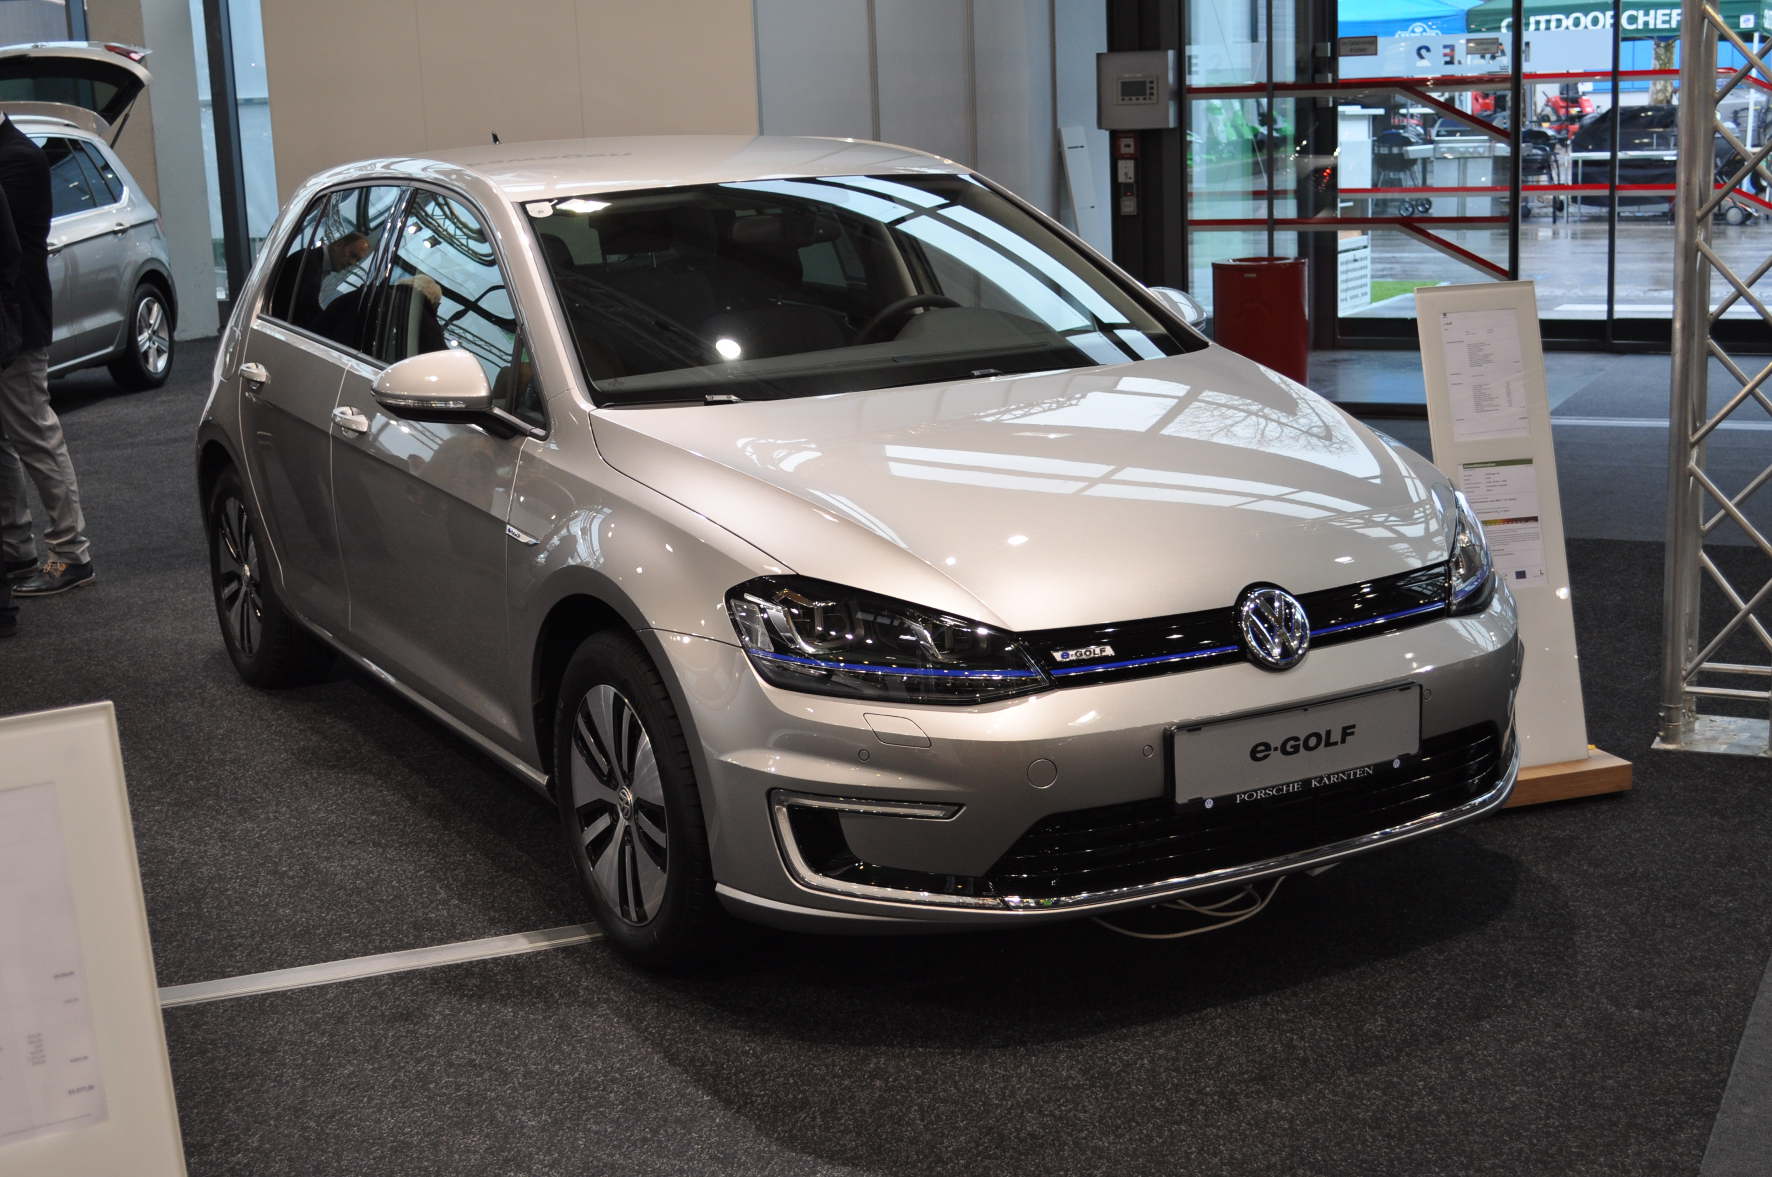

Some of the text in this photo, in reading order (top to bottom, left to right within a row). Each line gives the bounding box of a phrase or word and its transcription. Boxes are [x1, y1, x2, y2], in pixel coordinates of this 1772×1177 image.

[1060, 647, 1106, 660] e-GOLF
[1250, 724, 1356, 762] e-GOLF
[1236, 781, 1303, 804] PORSCHE
[1311, 766, 1375, 789] KÄRNTEN
